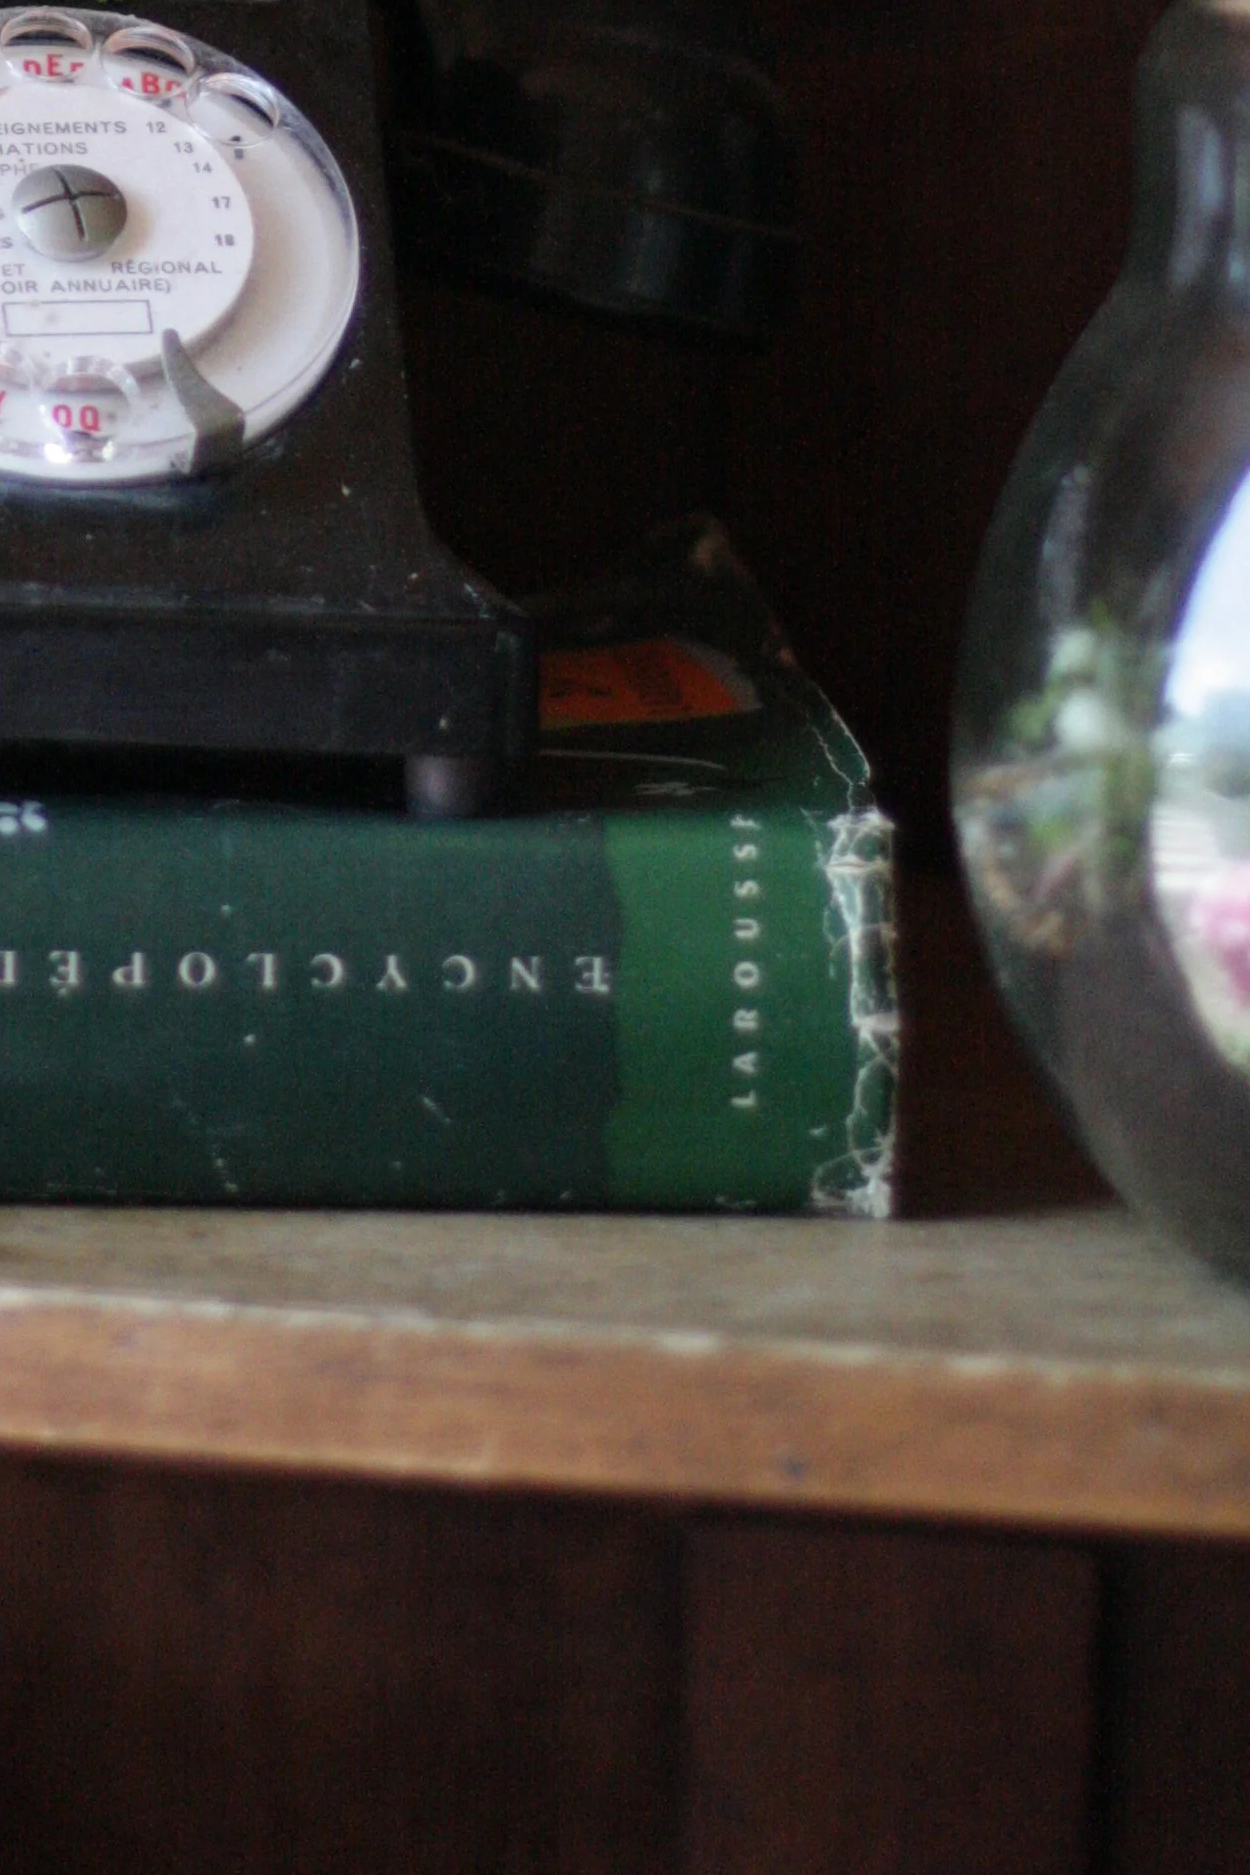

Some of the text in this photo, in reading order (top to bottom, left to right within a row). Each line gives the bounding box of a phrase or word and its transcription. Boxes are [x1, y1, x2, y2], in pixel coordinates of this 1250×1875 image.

[146, 120, 168, 135] 12
[174, 141, 195, 155] 13
[193, 161, 213, 175] 14
[211, 196, 232, 210] 17
[214, 234, 236, 248] 18
[1, 263, 26, 277] ET
[111, 259, 223, 276] RÉGIONAL
[51, 278, 172, 295] ANNUAIRE)
